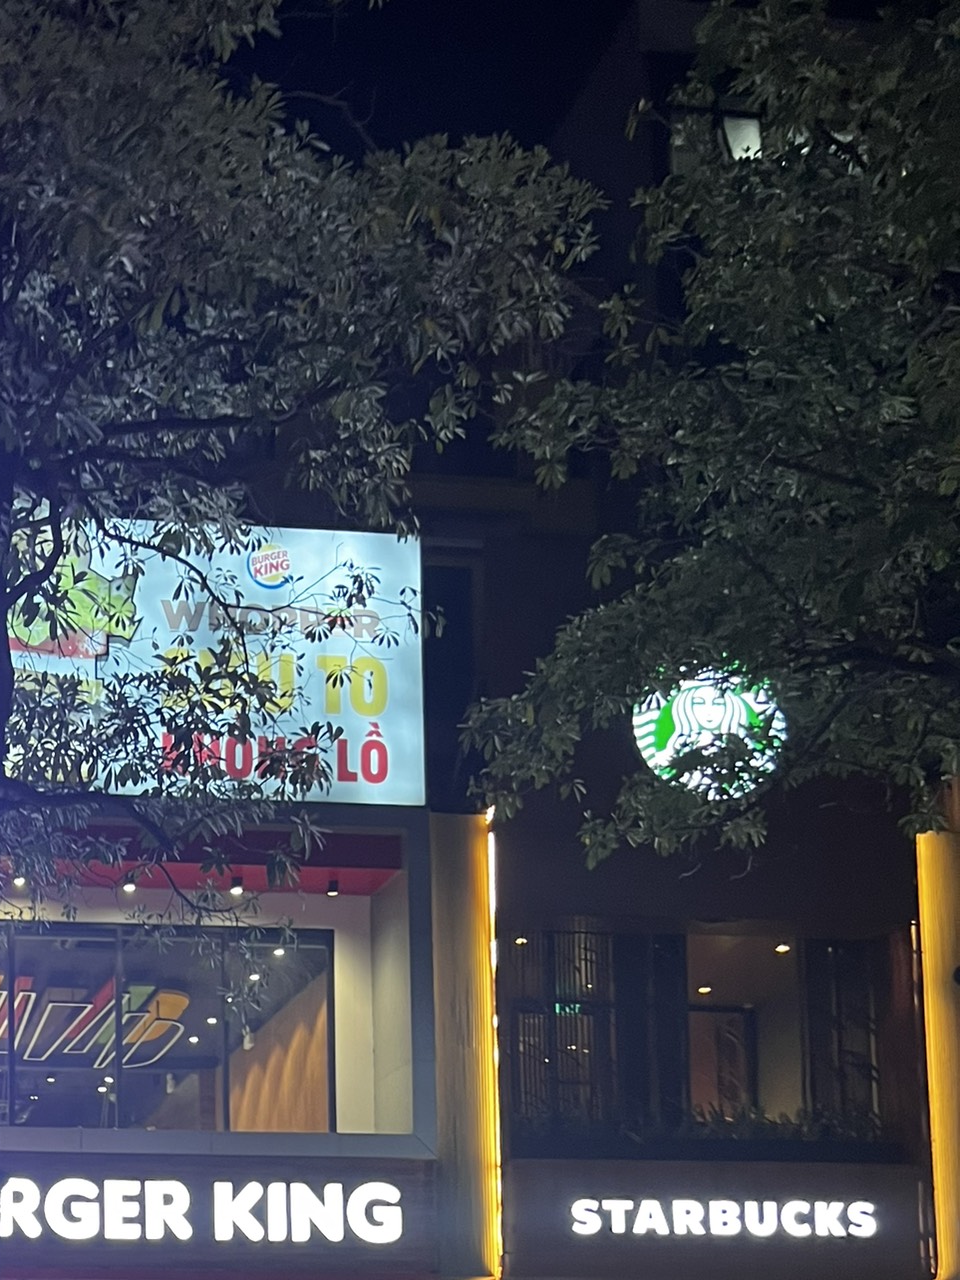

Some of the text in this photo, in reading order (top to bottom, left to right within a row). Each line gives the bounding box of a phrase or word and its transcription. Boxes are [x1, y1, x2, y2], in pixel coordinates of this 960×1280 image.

[251, 550, 288, 567] BURGER
[252, 559, 290, 578] KING
[317, 655, 388, 717] TO
[337, 722, 388, 784] LỒ
[214, 1181, 403, 1243] KING
[570, 1198, 877, 1238] STARBUCKS
